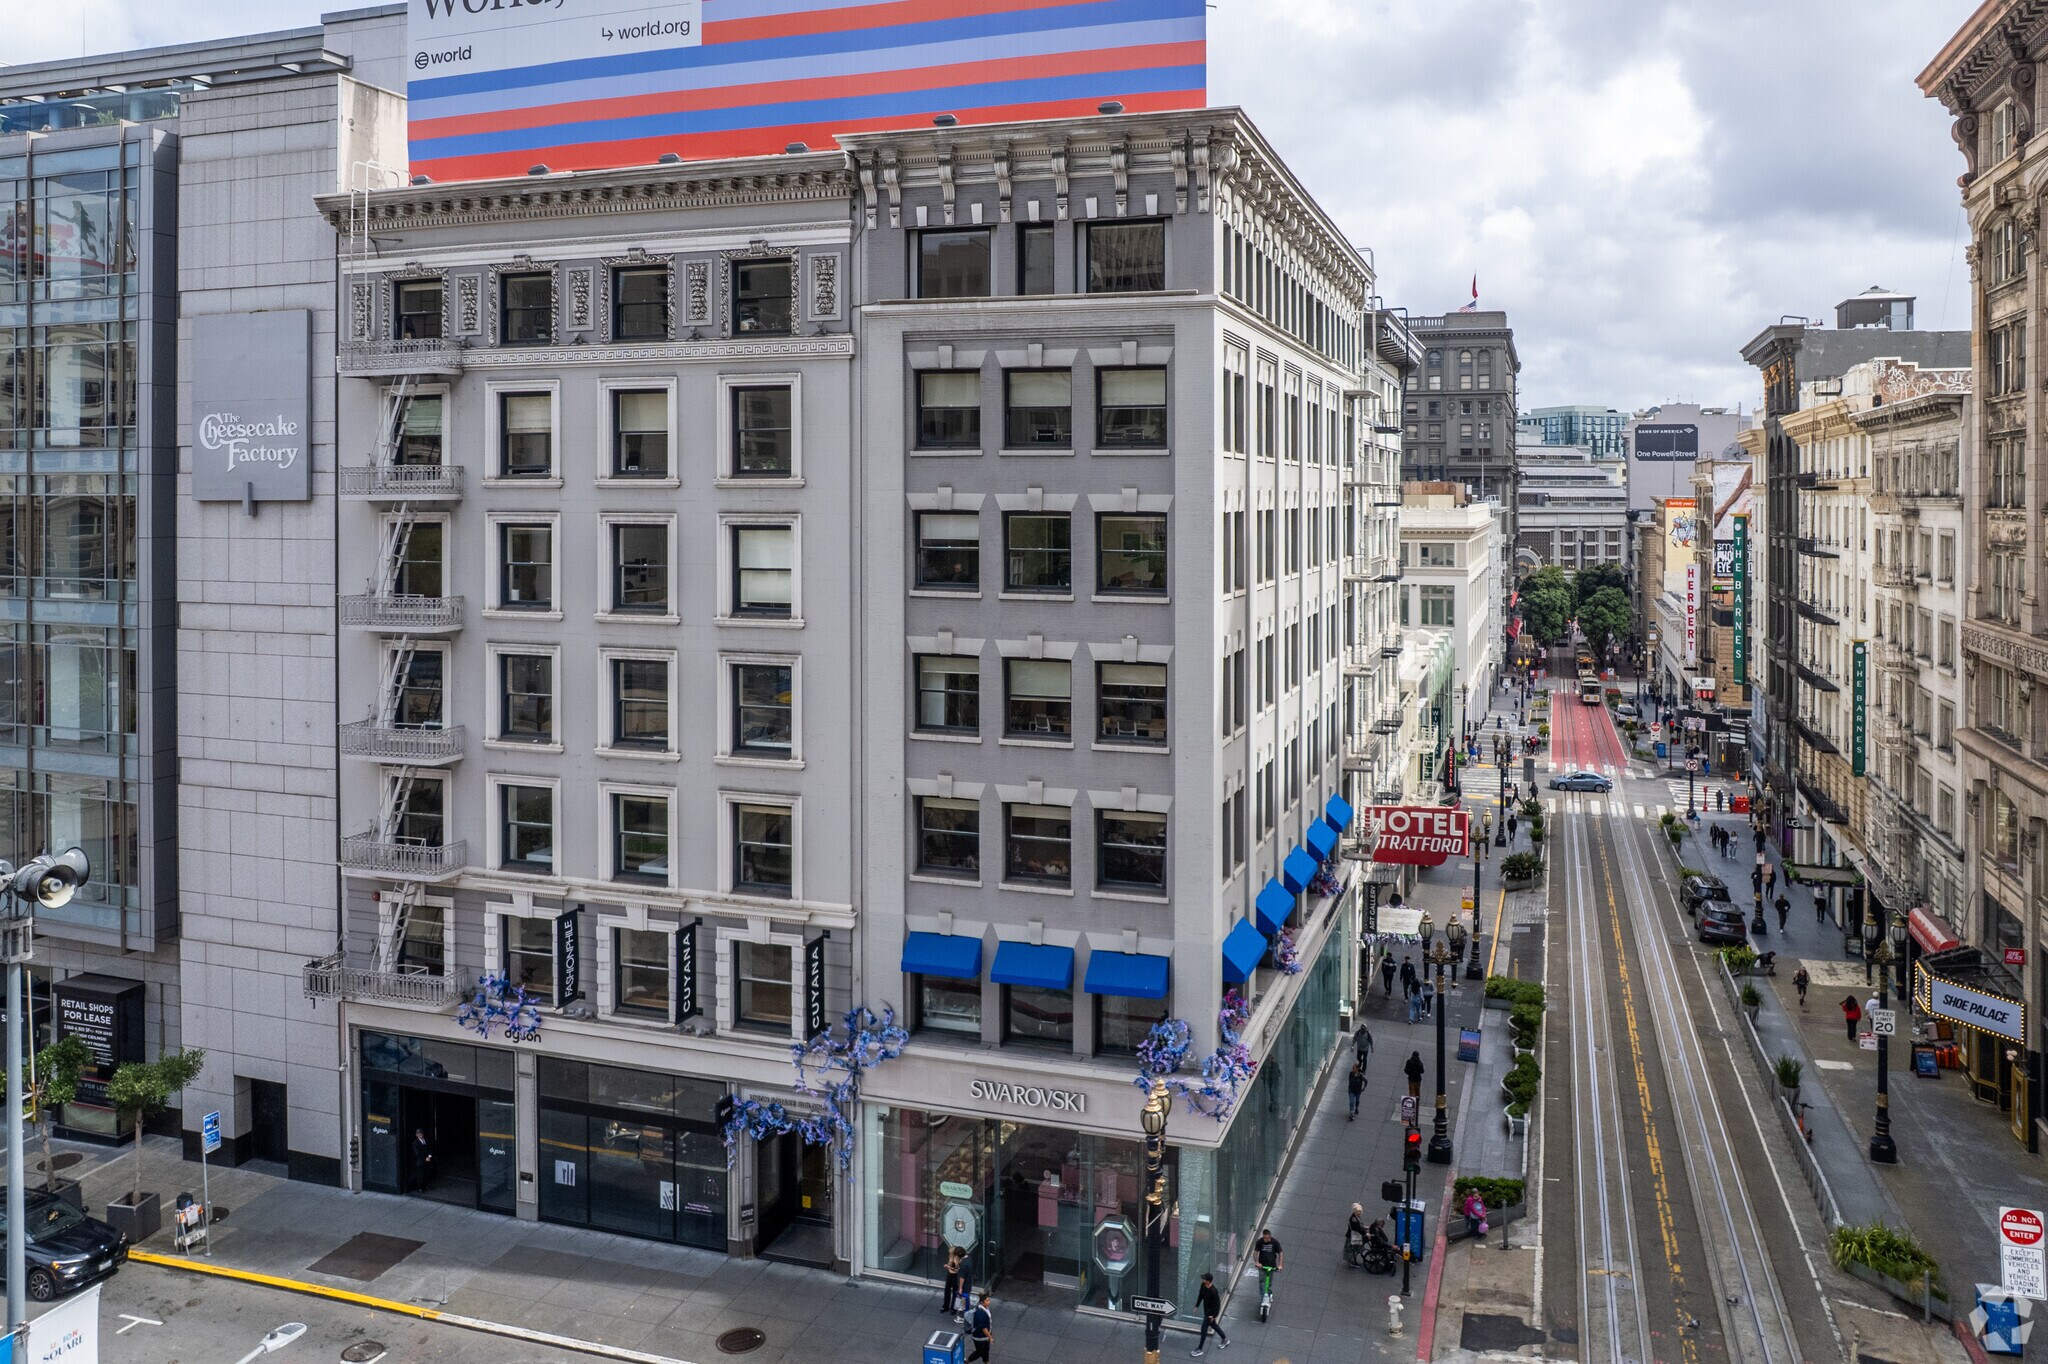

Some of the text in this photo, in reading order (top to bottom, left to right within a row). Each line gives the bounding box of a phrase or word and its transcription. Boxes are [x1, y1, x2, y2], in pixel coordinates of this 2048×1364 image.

[618, 20, 690, 41] world.org
[431, 45, 472, 64] world
[222, 413, 240, 423] The
[200, 412, 298, 450] Cheesecake
[220, 437, 299, 472] Factory
[1687, 568, 1695, 651] HERBERT
[1370, 810, 1464, 837] HOTEL
[1377, 834, 1462, 854] TRATFORD
[564, 919, 574, 998] FASHIONPHILE
[683, 932, 692, 1013] CUYANA
[811, 946, 820, 1029] CUYANA
[61, 999, 114, 1014] RETAIL SHOPS
[1943, 994, 2010, 1024] SHOE PALACE
[64, 1010, 111, 1025] FOR LEASE
[1875, 1022, 1893, 1033] 20
[504, 1028, 542, 1043] dyson
[971, 1080, 1086, 1112] SWAROVSKI
[372, 1126, 388, 1135] dyson
[489, 1147, 505, 1155] dyson
[2021, 1216, 2036, 1224] NOT
[2009, 1230, 2034, 1240] ENTER
[2005, 1255, 2042, 1265] COMMERCIAL
[2010, 1249, 2035, 1257] EXCEPT
[2008, 1261, 2039, 1270] VEHICLES
[2009, 1274, 2039, 1282] VEHICLES
[2010, 1280, 2038, 1288] LOADING
[2017, 1287, 2043, 1295] POWELL
